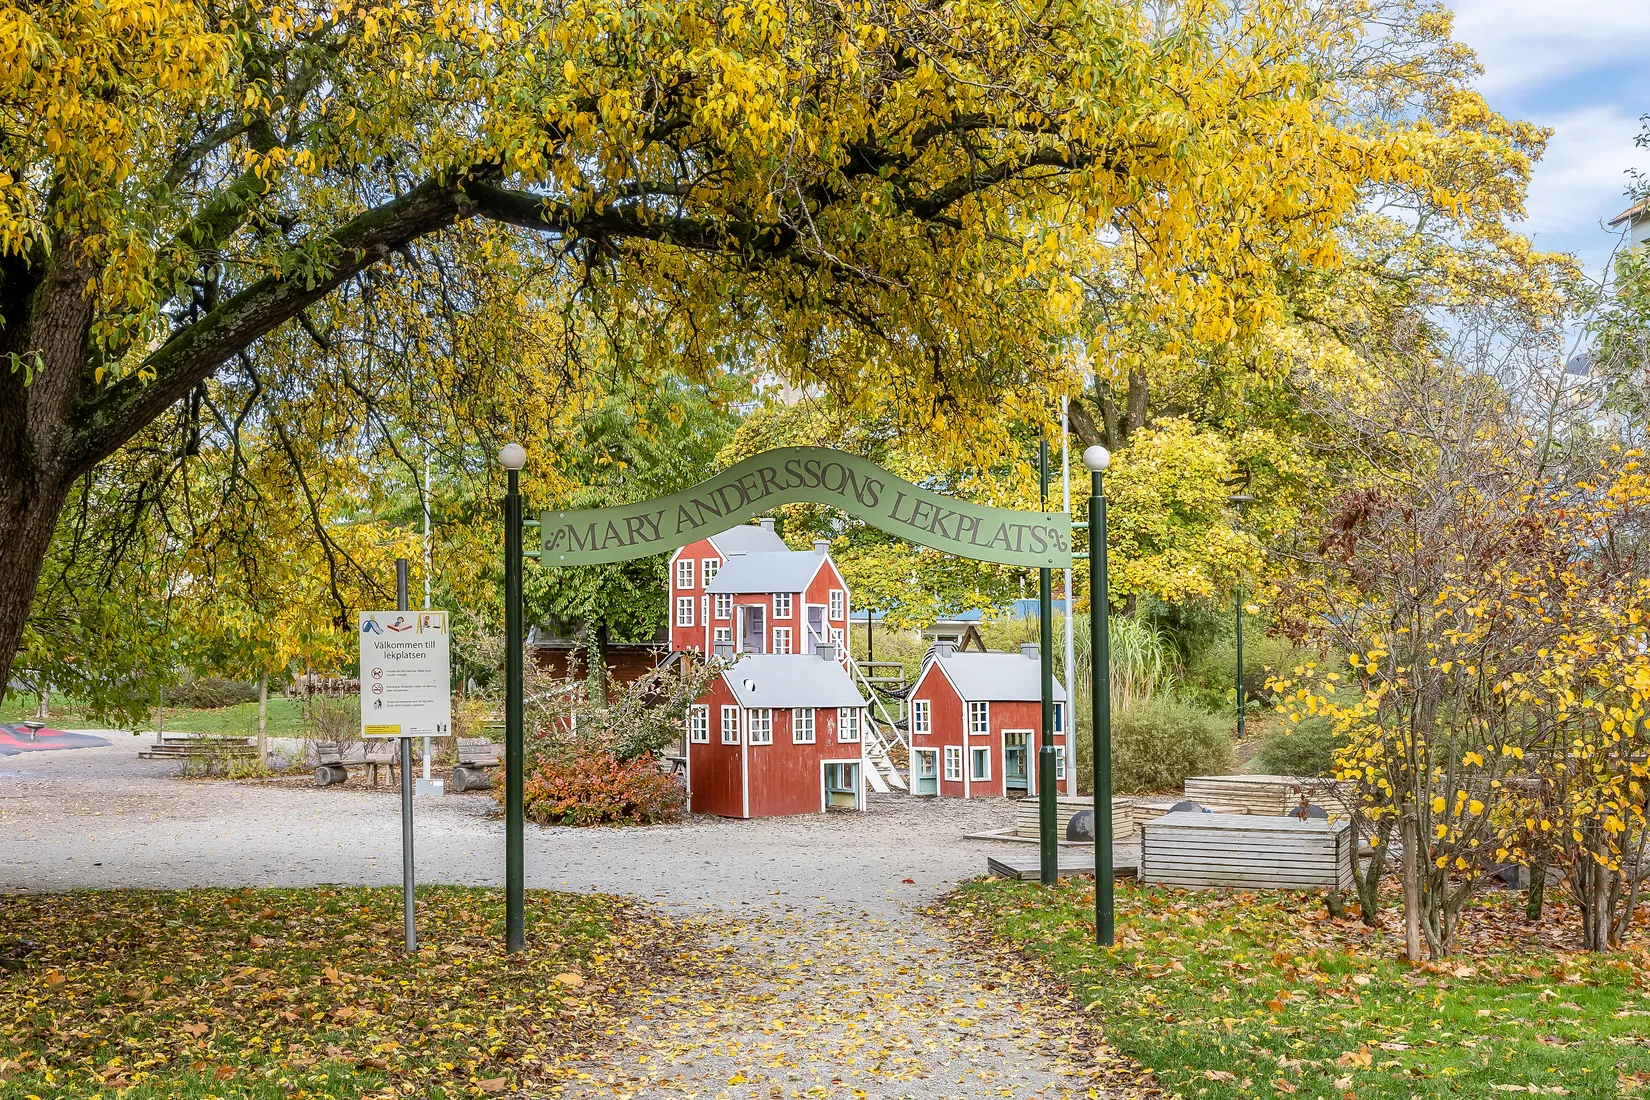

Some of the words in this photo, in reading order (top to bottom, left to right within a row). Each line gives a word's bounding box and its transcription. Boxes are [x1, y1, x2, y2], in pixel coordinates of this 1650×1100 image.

[565, 510, 665, 552] MARY
[675, 459, 885, 534] ANDERSSONS
[888, 491, 1050, 554] LEKPLATS
[374, 641, 423, 649] Välkommen
[384, 651, 426, 660] lekplatsen
